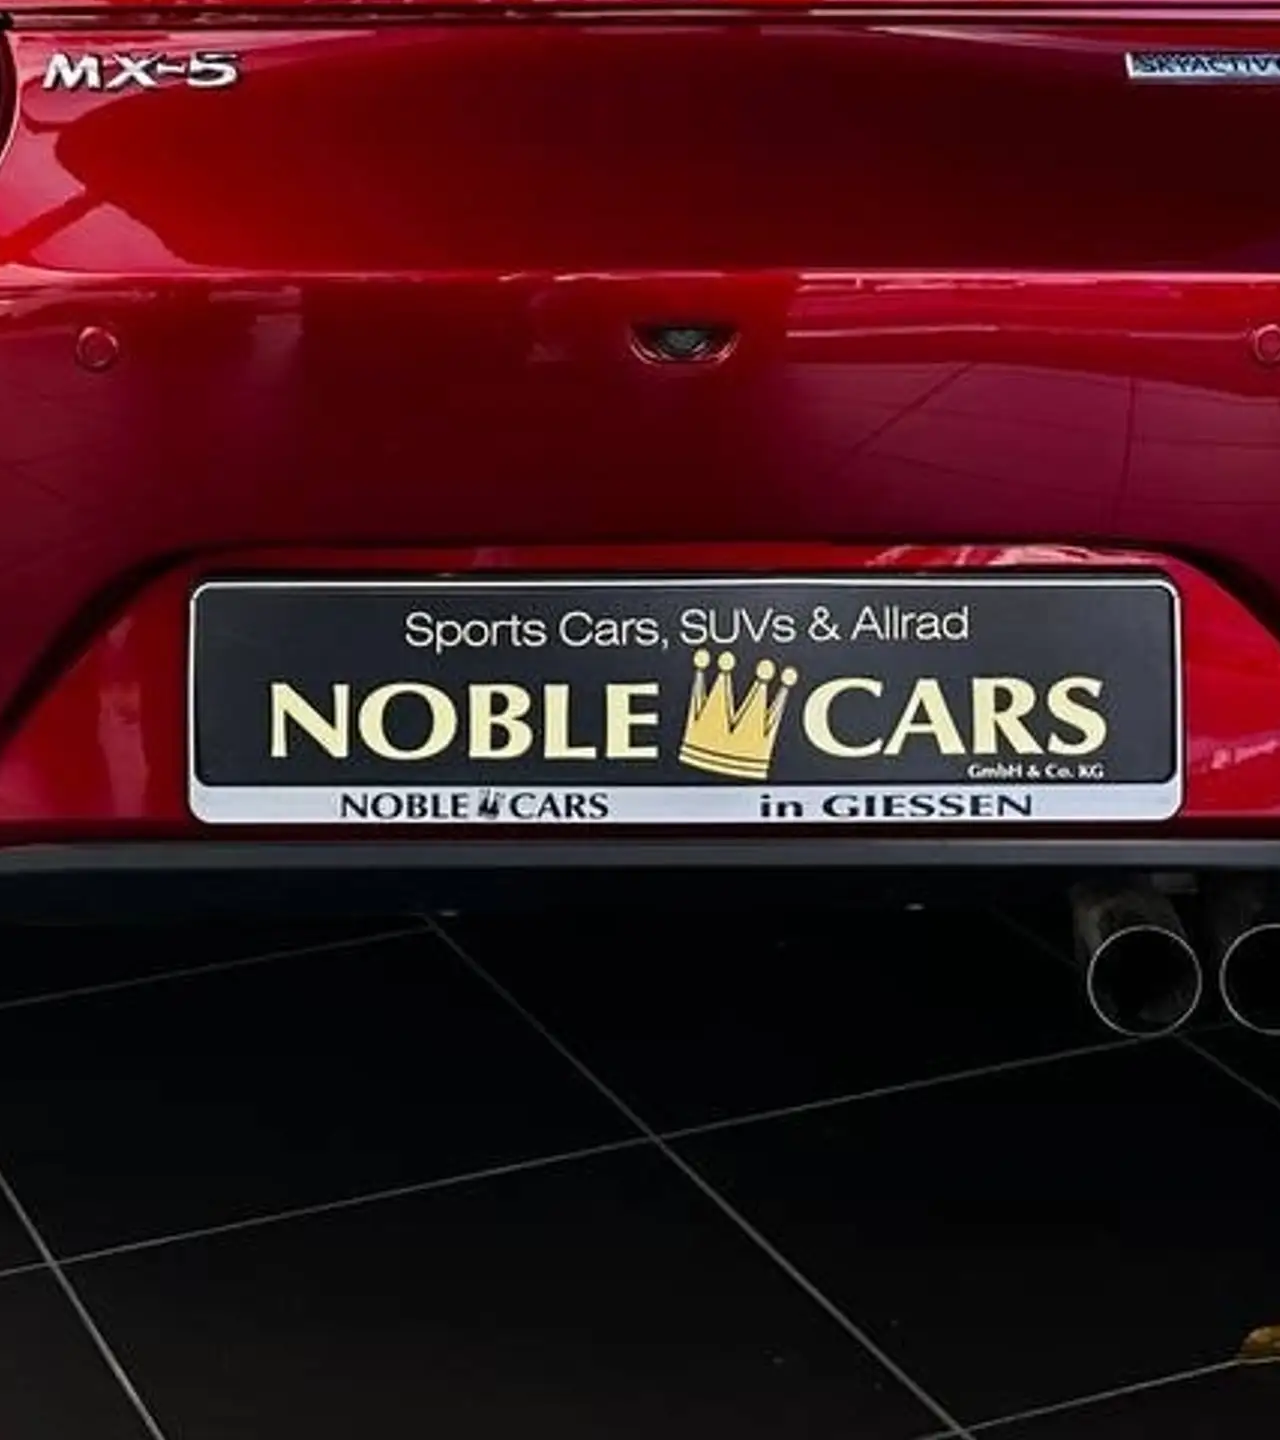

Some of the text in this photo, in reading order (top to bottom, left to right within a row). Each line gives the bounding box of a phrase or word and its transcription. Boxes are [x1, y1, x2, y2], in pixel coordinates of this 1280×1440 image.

[42, 50, 238, 89] MX-5
[404, 605, 970, 653] Sports Cars, SUVs & Allrad
[270, 676, 1108, 760] NOBLE CARS
[967, 764, 1105, 779] GmbH & Co. KG
[340, 792, 1032, 819] NOBLE CARS in GIESSEN
